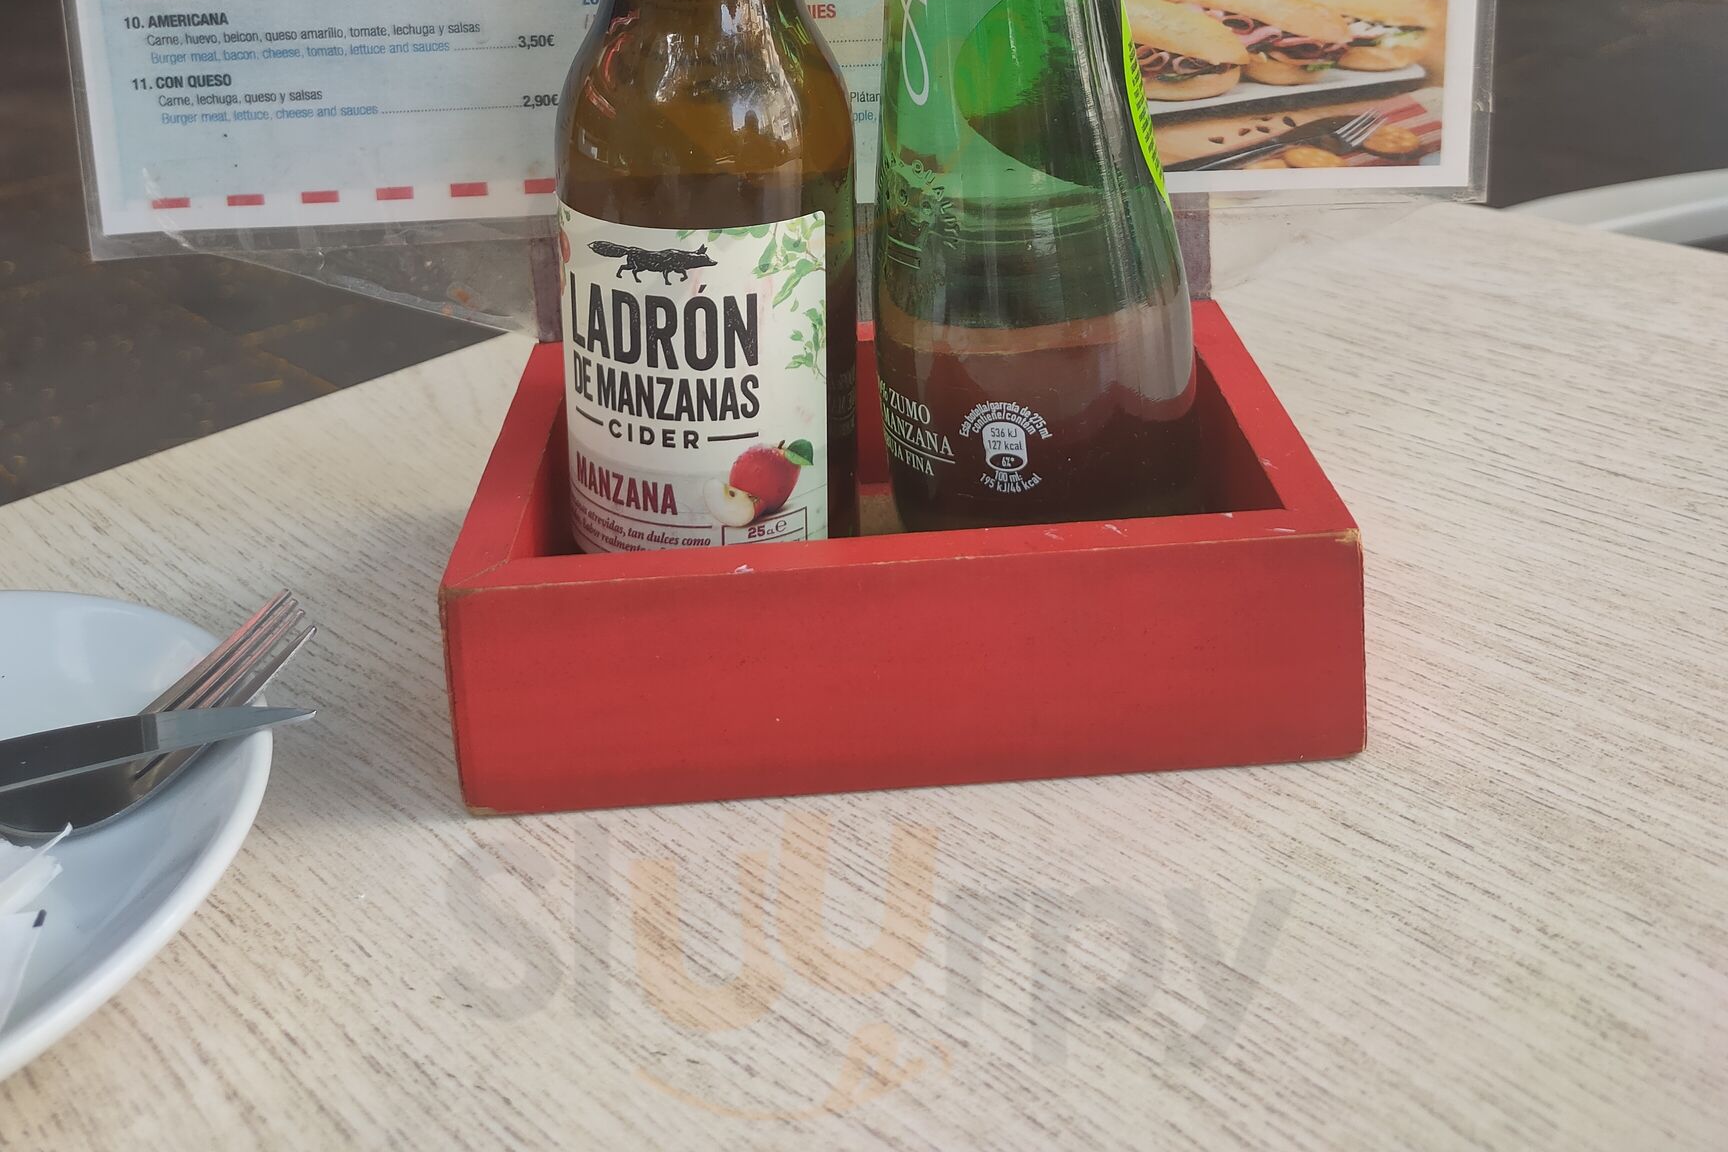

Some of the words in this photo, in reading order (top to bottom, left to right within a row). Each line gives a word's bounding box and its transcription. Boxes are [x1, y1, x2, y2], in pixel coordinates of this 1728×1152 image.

[124, 16, 144, 29] 10.
[148, 13, 229, 28] AMERICANA
[518, 35, 555, 49] 3,50€
[133, 78, 152, 90] 11.
[156, 76, 183, 89] CON
[188, 74, 232, 88] QUESO
[523, 94, 559, 109] 2,90€
[570, 271, 759, 371] LADRÓN
[574, 349, 593, 401] DE
[597, 365, 759, 422] MANZANAS
[889, 388, 930, 425] ZUMO
[609, 419, 699, 448] CIDER
[883, 404, 955, 457] MANZANA
[991, 428, 1005, 437] 536
[1008, 429, 1017, 437] kJ
[989, 441, 1001, 449] 127
[1004, 441, 1022, 450] kcal
[906, 452, 934, 476] FINA
[577, 451, 678, 515] MANZANA
[588, 507, 626, 538] atrevidas,
[627, 527, 644, 542] tan
[647, 532, 679, 545] dulces
[682, 537, 711, 547] como
[748, 525, 766, 539] 25
